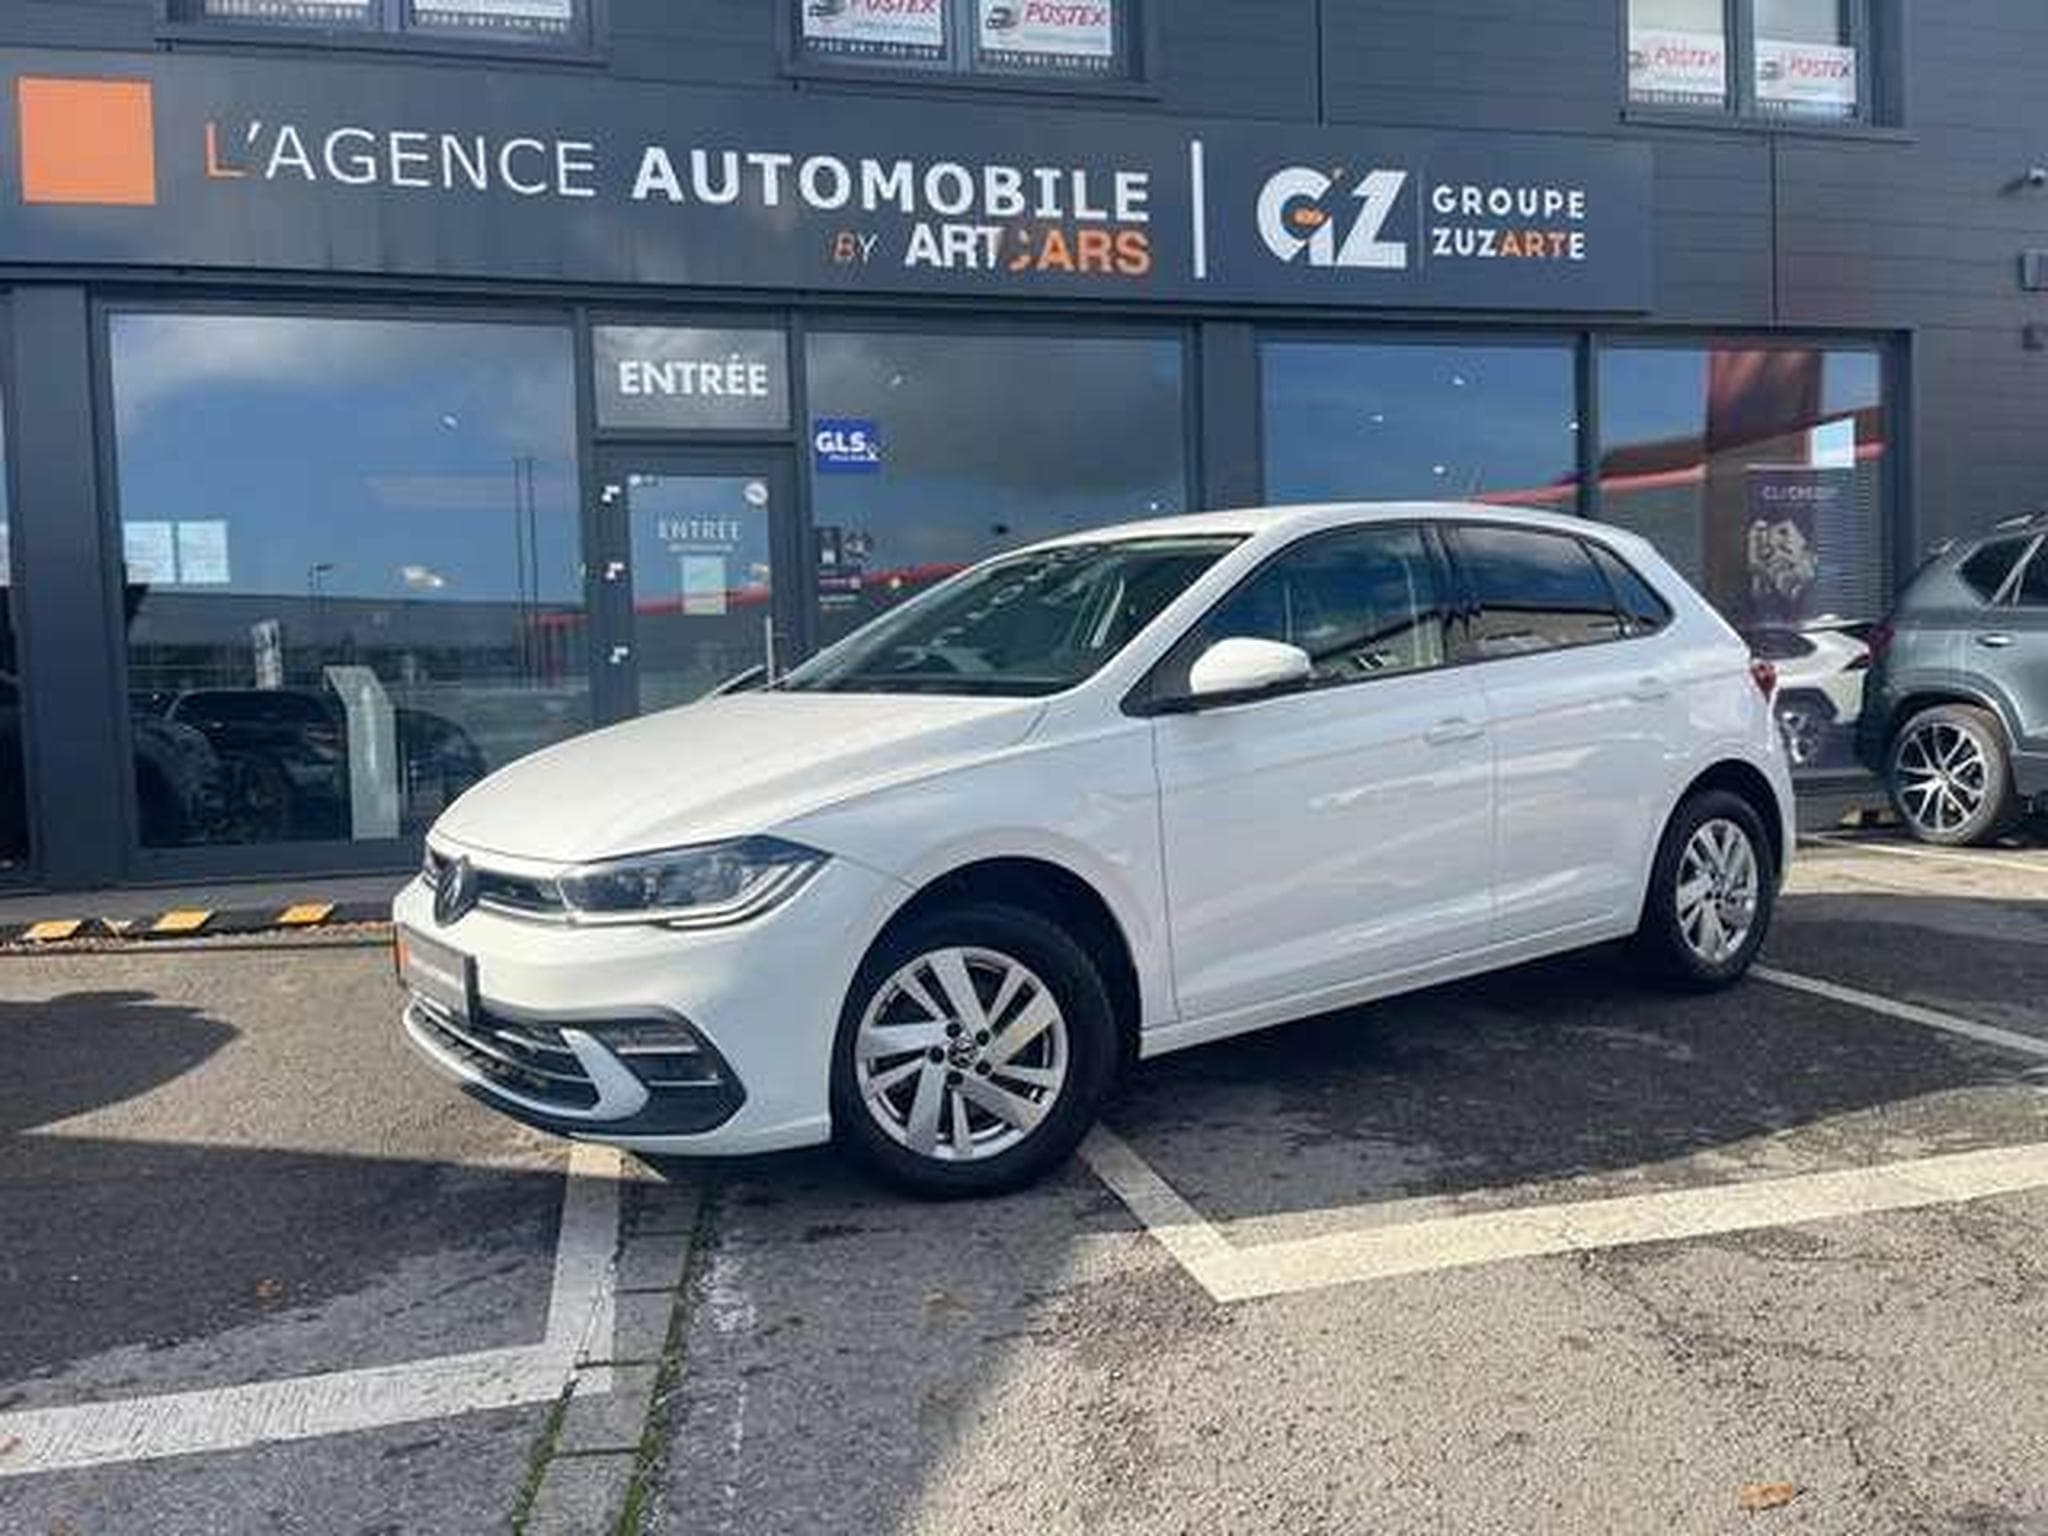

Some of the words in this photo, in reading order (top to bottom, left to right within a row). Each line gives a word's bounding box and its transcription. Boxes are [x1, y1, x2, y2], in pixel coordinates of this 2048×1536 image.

[1024, 2, 1109, 26] POSTEX
[1788, 57, 1850, 78] POSTEX
[204, 120, 597, 197] L'AGENCE
[630, 145, 1150, 222] AUTOMOBILE
[1431, 185, 1586, 219] GROUPE
[833, 232, 878, 265] BY
[1431, 228, 1586, 260] ZUZARTE
[618, 353, 769, 396] ENTRÉE
[815, 431, 867, 454] GLS
